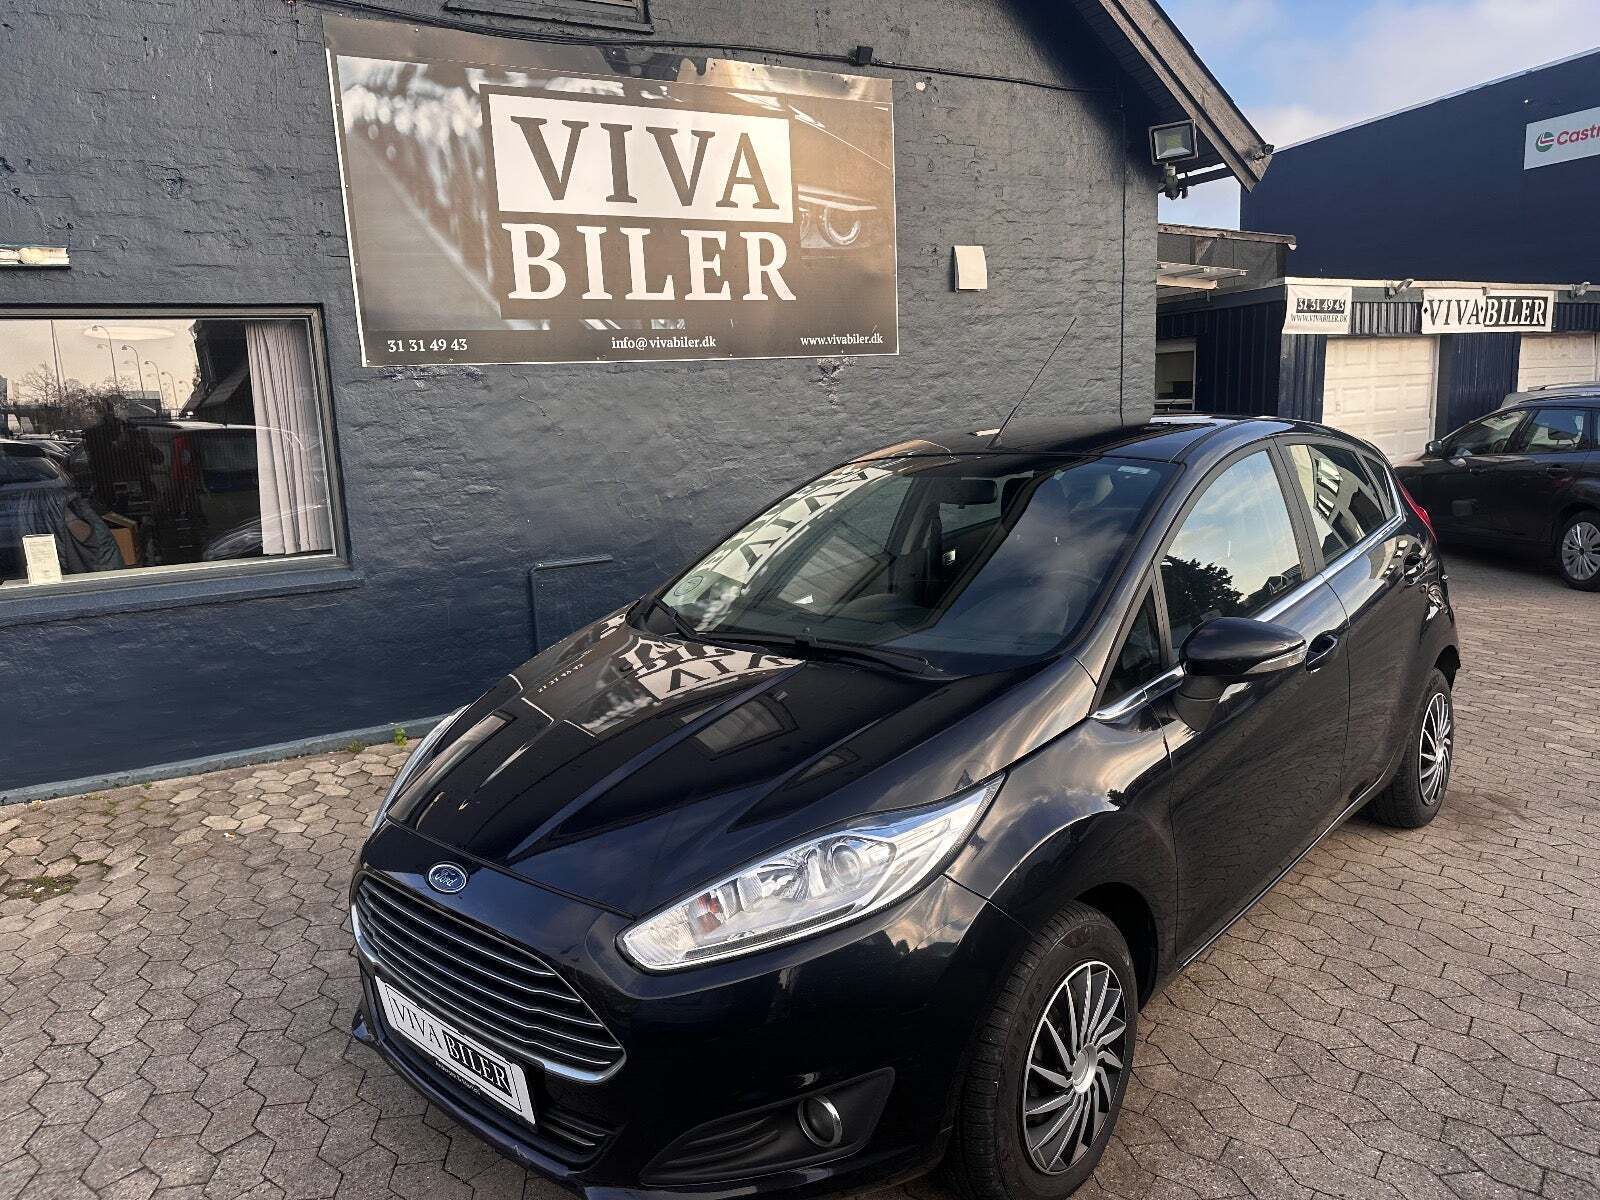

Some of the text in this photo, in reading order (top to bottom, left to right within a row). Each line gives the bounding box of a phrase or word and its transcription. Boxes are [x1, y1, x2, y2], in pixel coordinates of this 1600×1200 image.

[510, 116, 779, 209] VIVA
[502, 223, 796, 300] BILER
[1298, 299, 1344, 311] 31 31 49 43
[1427, 298, 1545, 326] VIVA BILER
[387, 338, 468, 352] 31 31 49 43
[800, 333, 884, 346] www.vivabiler.dk
[391, 997, 443, 1050] VIVA
[445, 1034, 512, 1095] BILER
